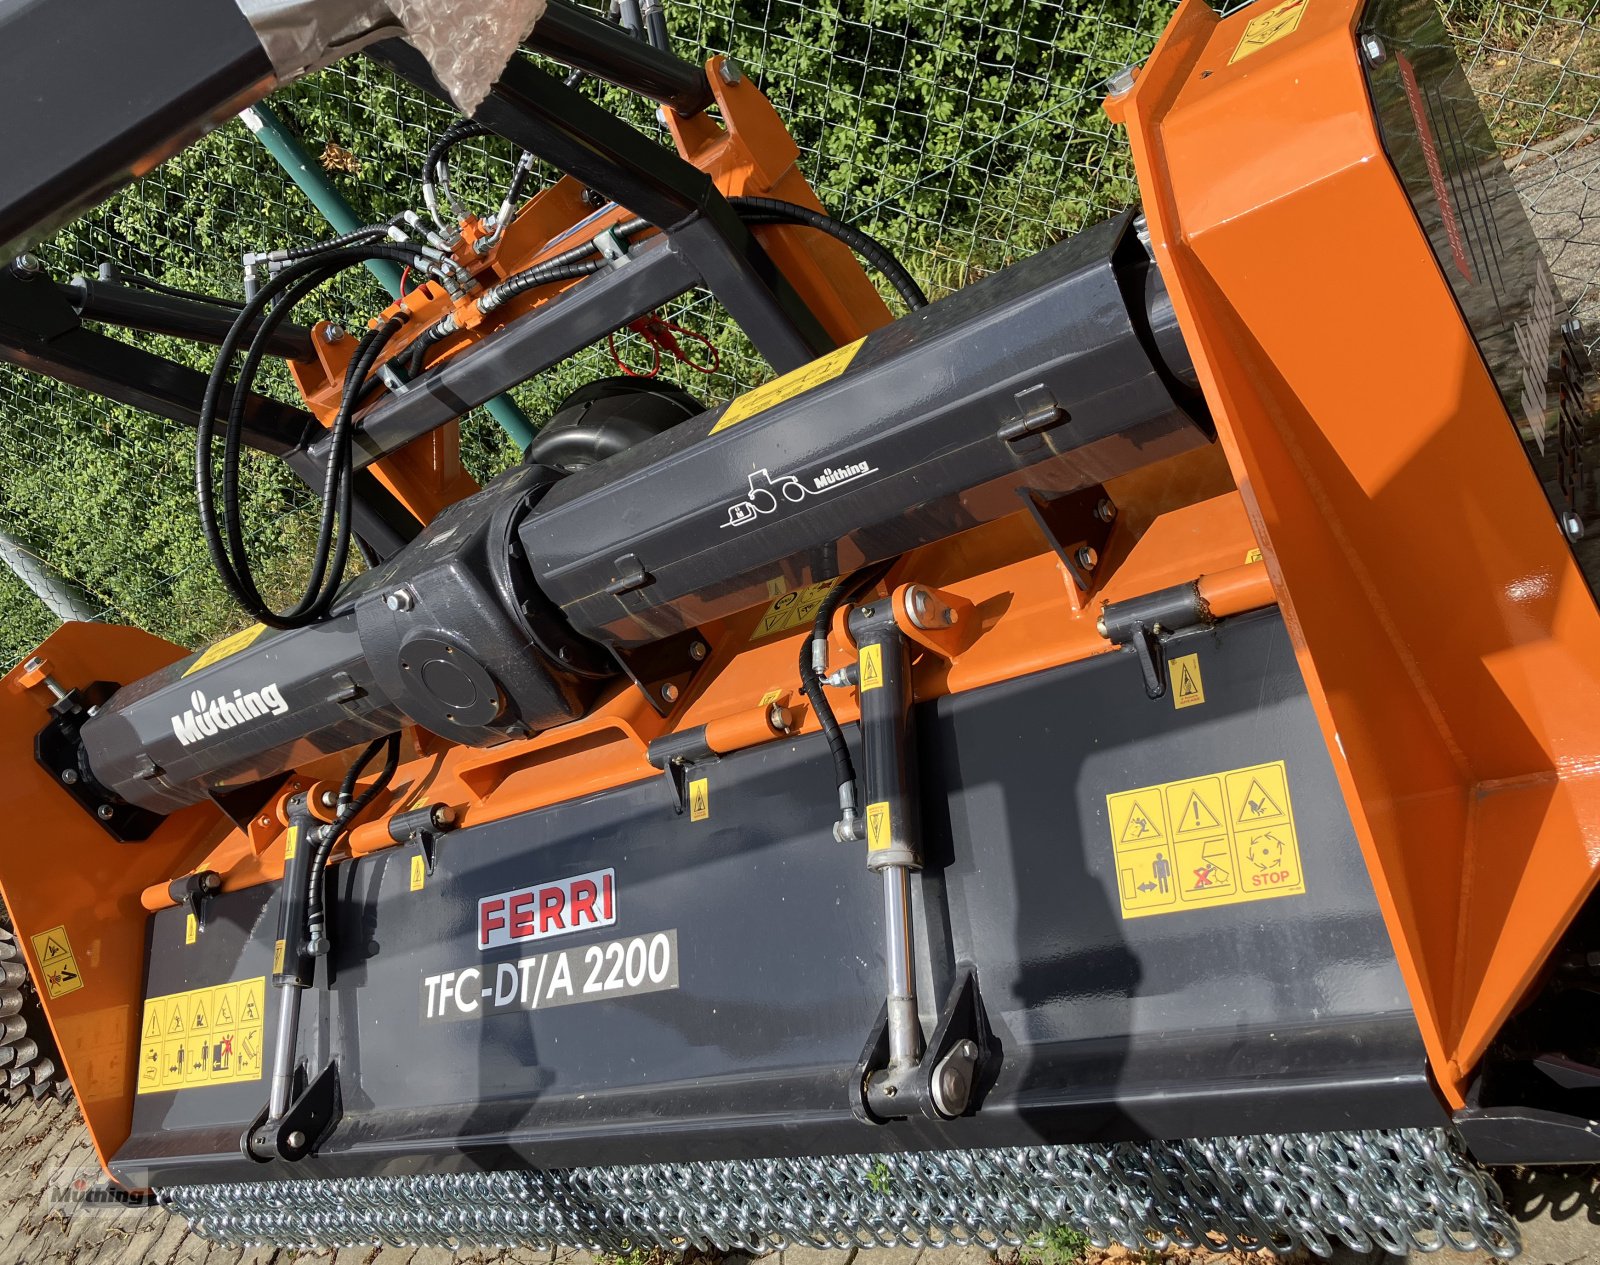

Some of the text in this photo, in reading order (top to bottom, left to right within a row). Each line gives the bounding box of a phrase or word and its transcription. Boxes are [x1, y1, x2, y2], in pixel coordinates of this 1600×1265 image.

[1513, 258, 1556, 457] Müthing
[813, 460, 870, 489] Müthing
[170, 682, 289, 747] Müthing
[480, 873, 613, 945] FERRI
[1251, 870, 1290, 886] STOP
[424, 933, 670, 1018] TFC-DT/A 2200
